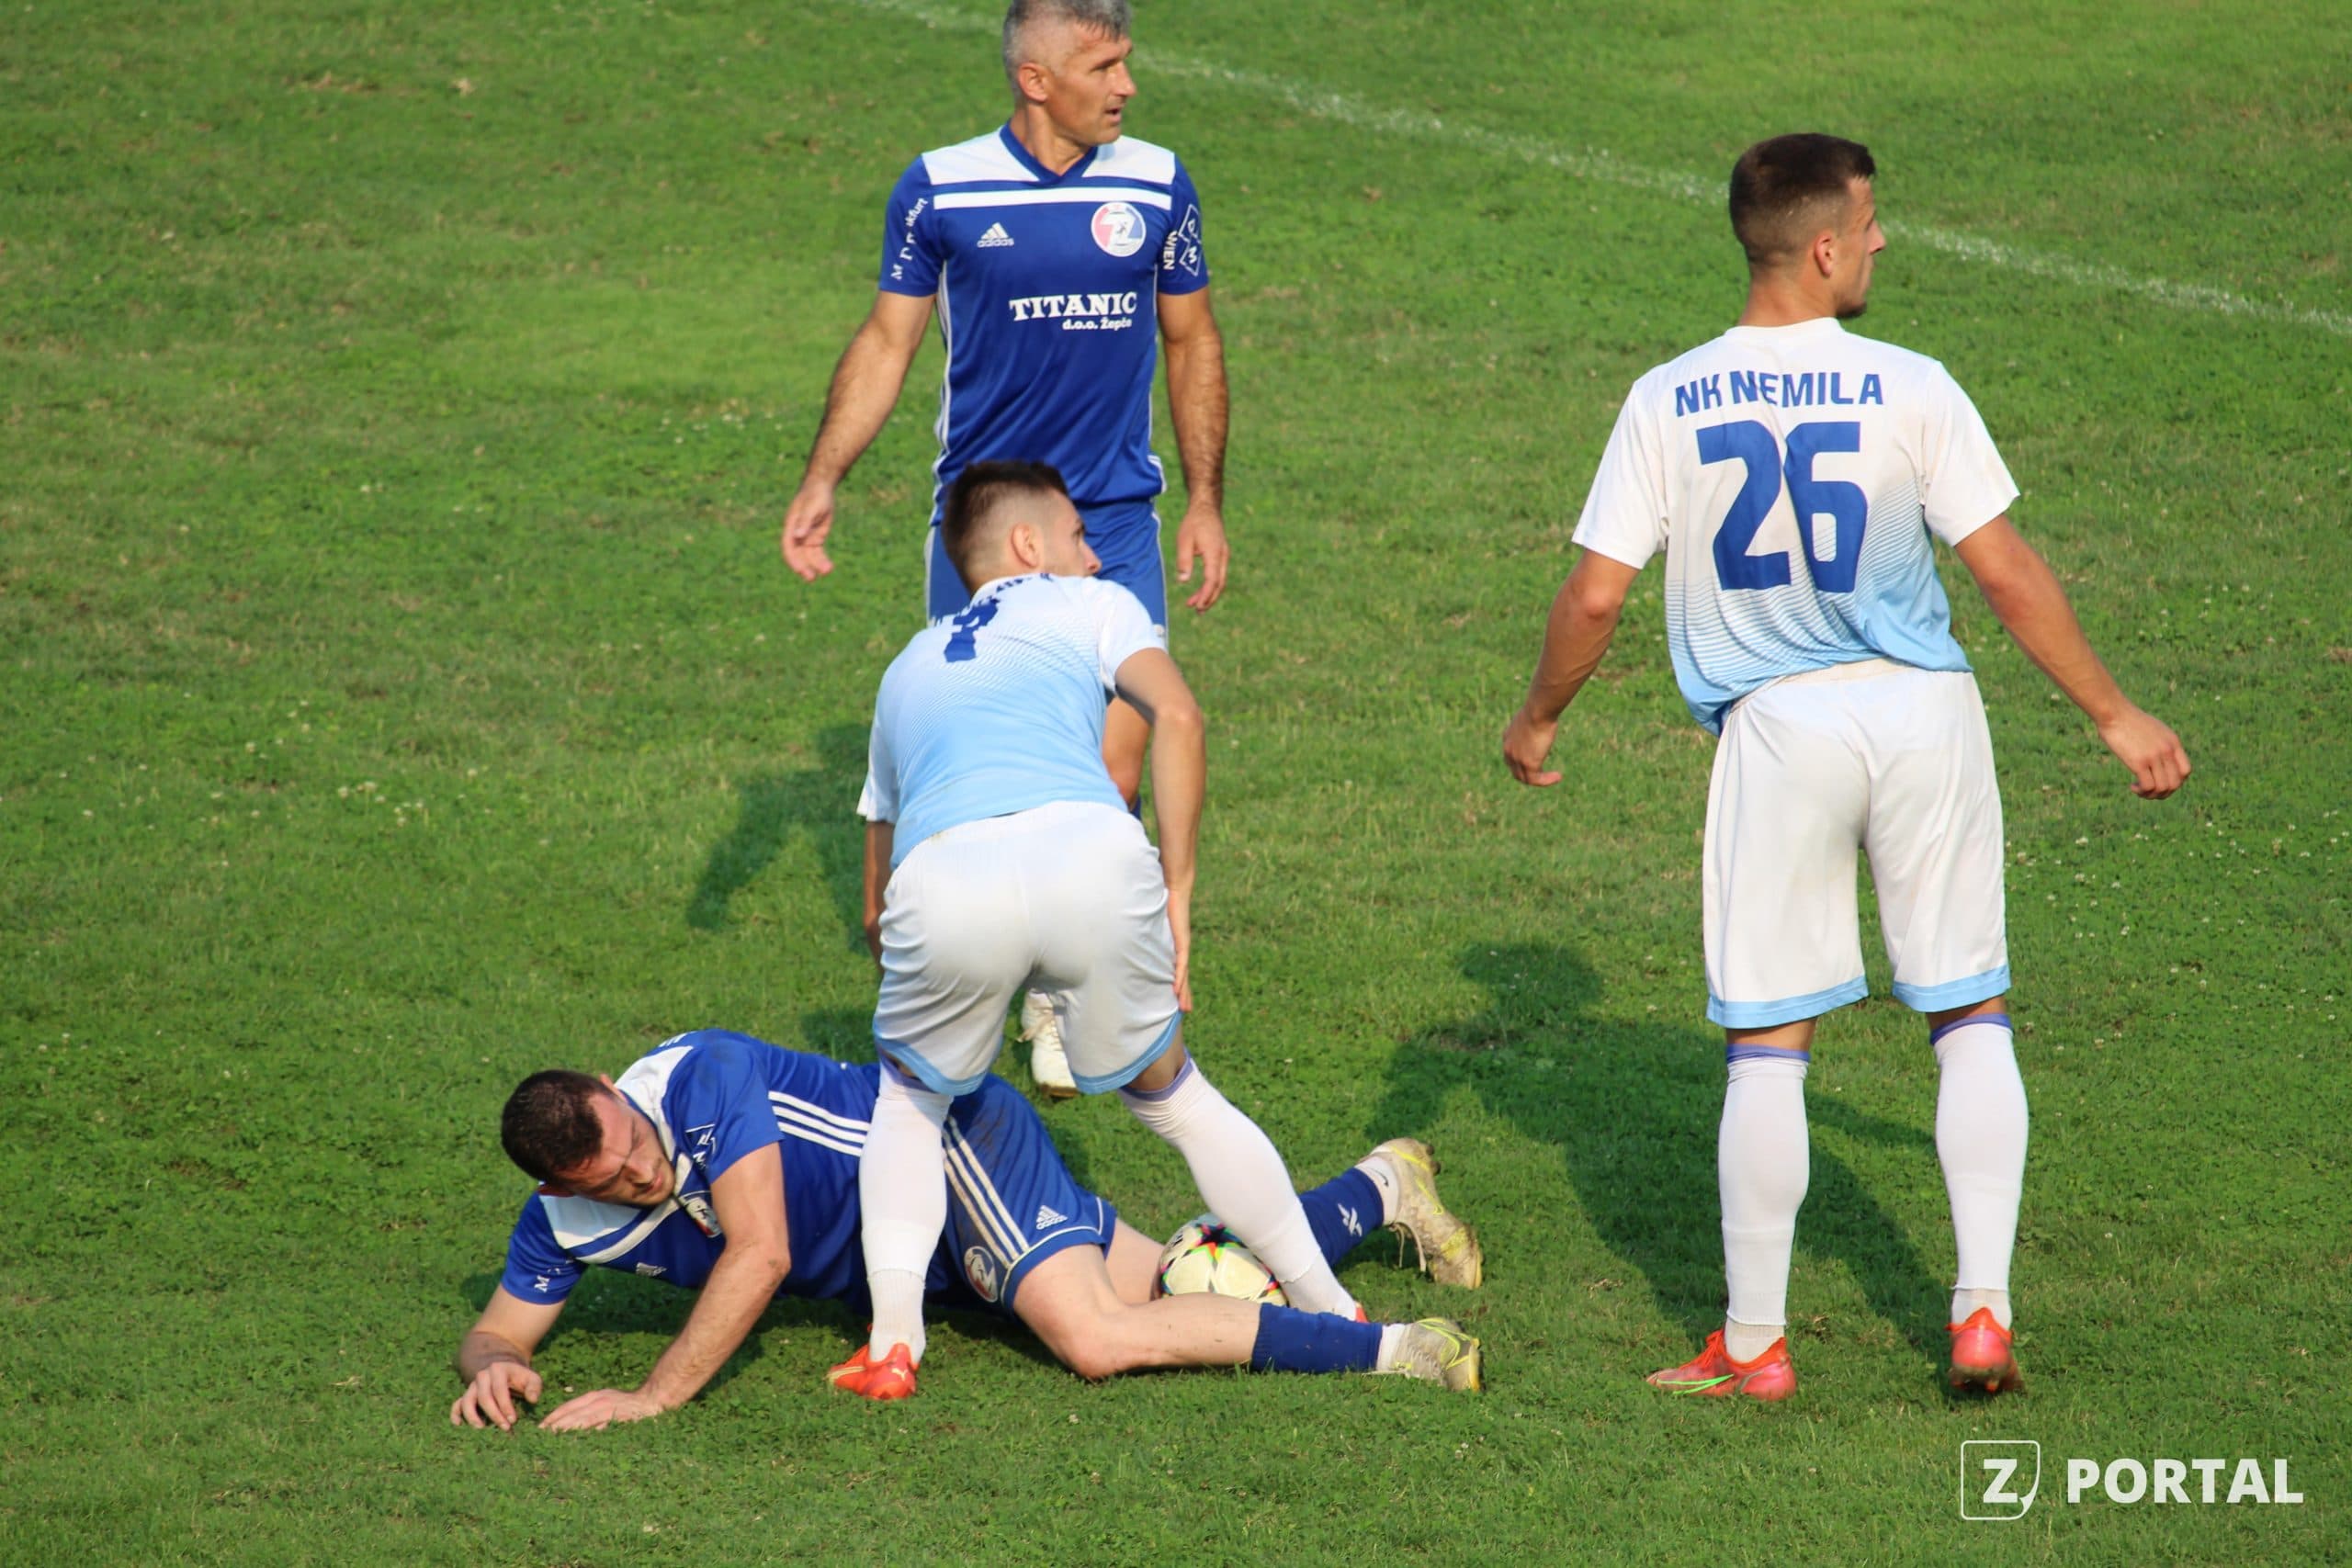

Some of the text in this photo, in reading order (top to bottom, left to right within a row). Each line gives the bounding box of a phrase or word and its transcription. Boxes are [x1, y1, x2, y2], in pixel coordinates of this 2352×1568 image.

[977, 238, 1014, 248] adidas
[1162, 230, 1178, 270] WIEN
[1009, 291, 1137, 321] TITANIC
[1062, 318, 1098, 330] d.o.o.
[1675, 370, 1883, 417] NK NEMILA
[1696, 419, 1868, 593] 26
